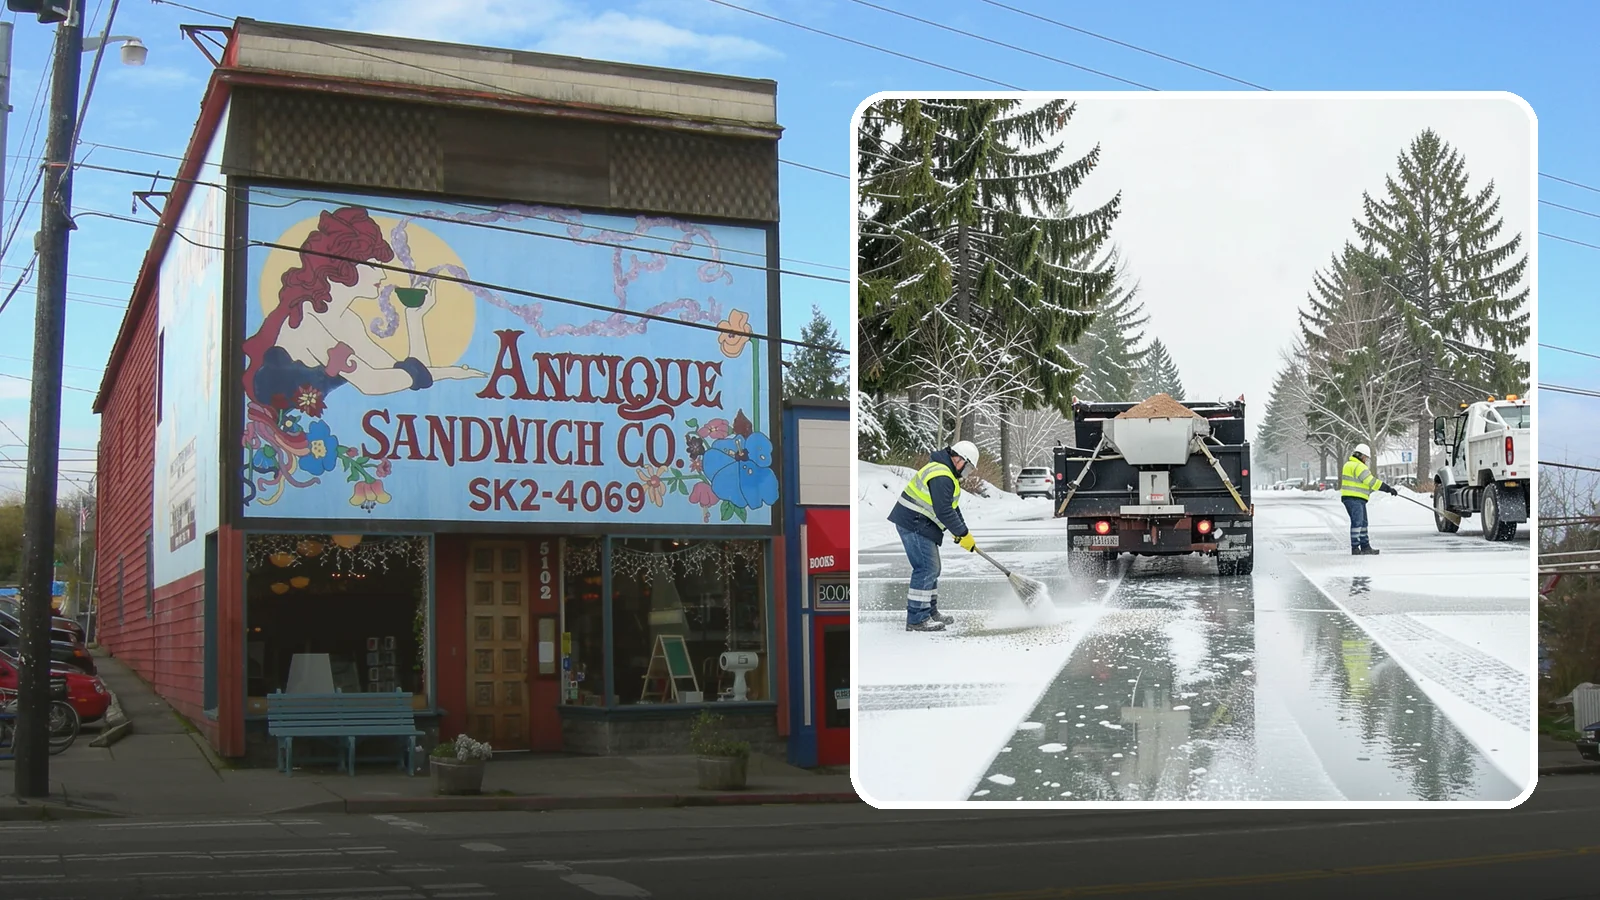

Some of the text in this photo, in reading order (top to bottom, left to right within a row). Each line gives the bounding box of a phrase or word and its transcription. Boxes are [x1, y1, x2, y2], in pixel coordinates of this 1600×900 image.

[475, 328, 724, 421] ANTIQUE
[360, 408, 685, 469] SANDWICH CO.
[468, 477, 646, 513] SK2-4069
[539, 541, 552, 600] 5102
[809, 555, 835, 569] BOOKS
